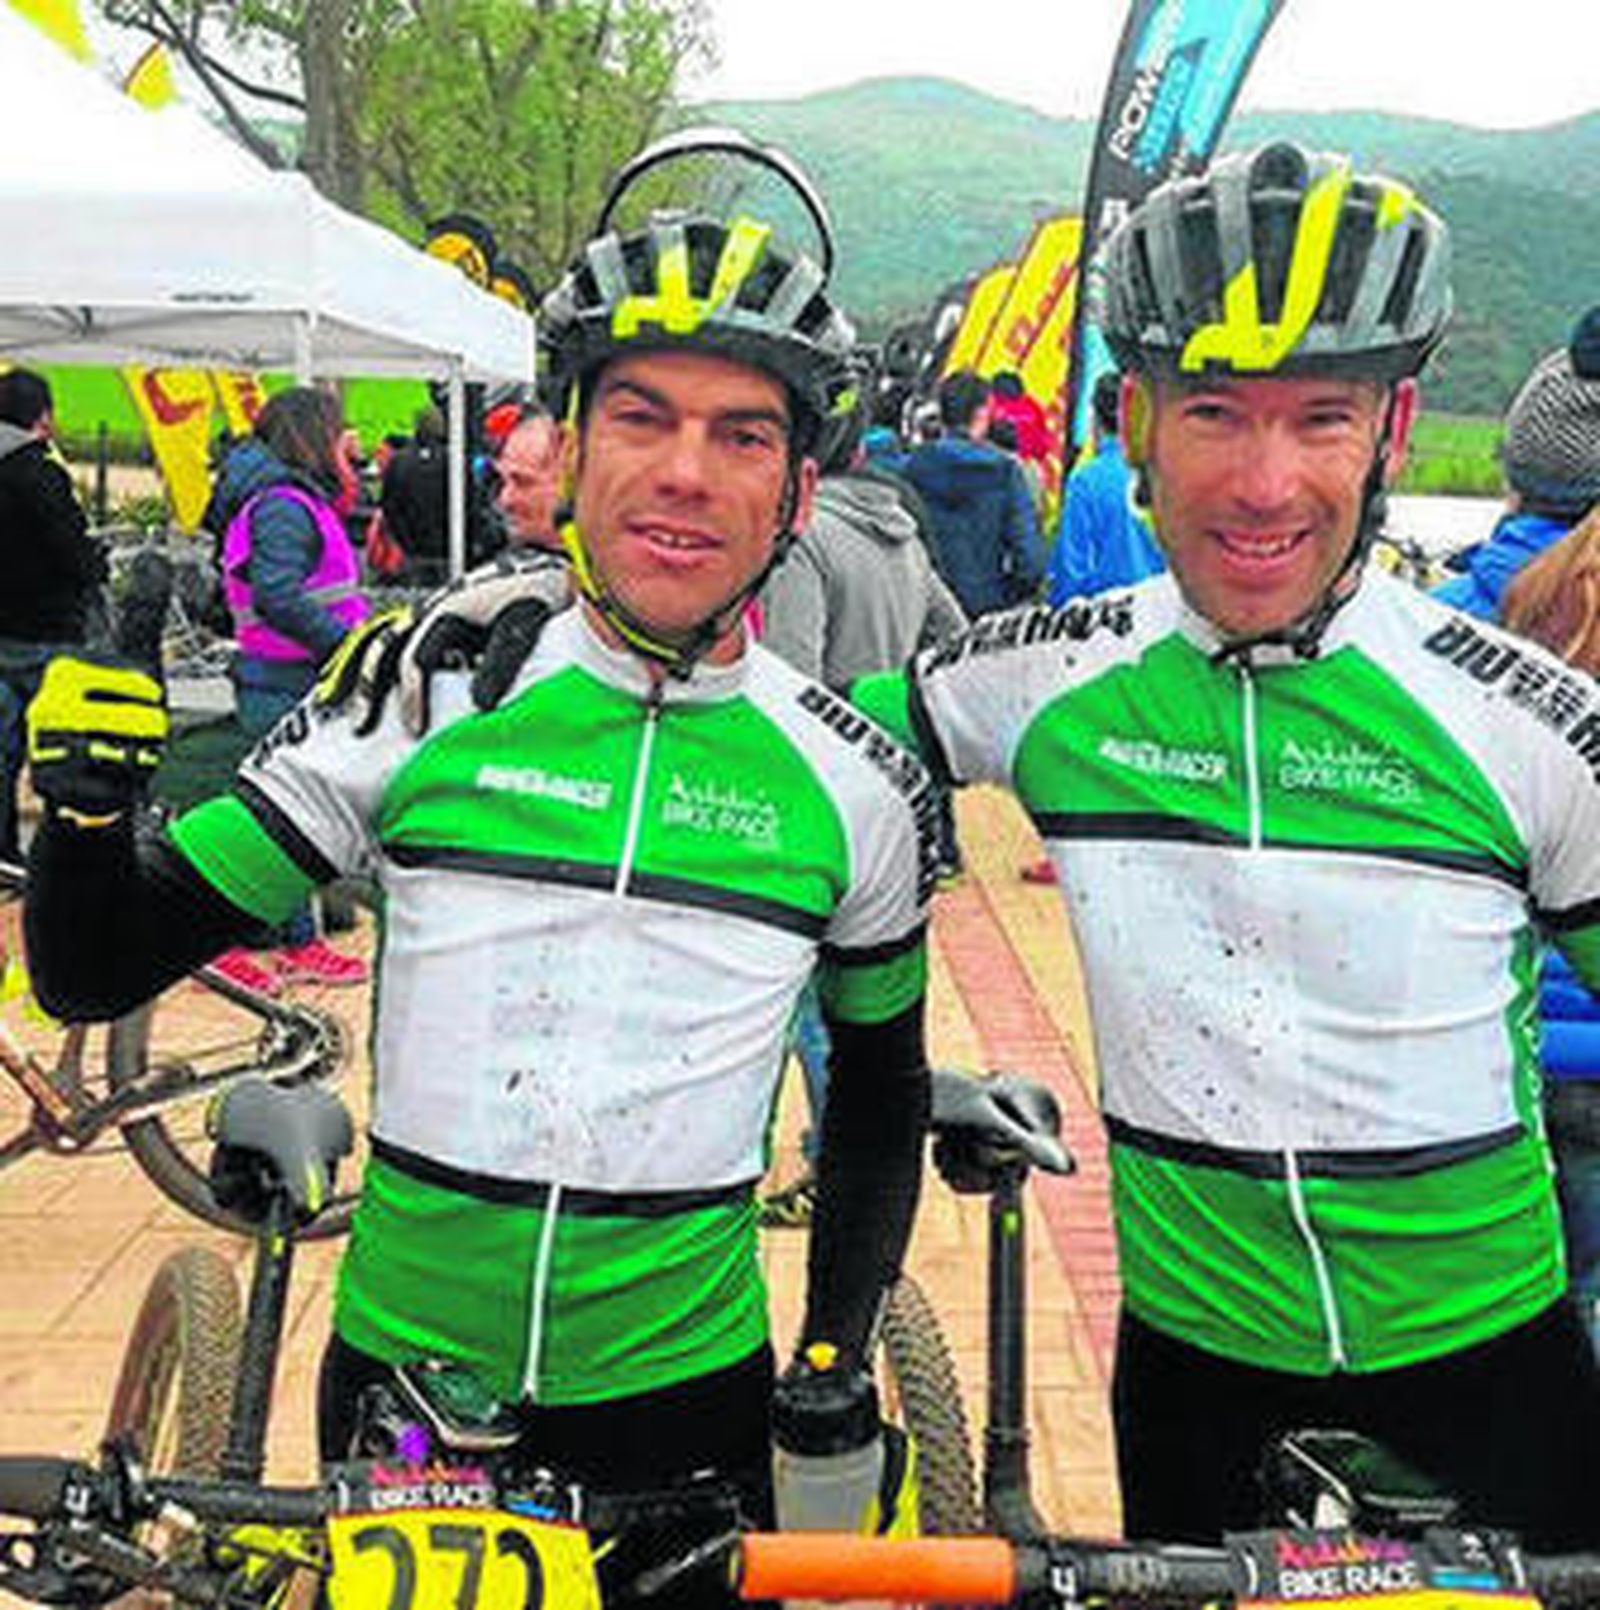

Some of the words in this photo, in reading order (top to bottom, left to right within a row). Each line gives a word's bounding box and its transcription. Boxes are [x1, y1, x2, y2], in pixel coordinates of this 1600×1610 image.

[370, 1485, 429, 1511] BIKE
[431, 1483, 498, 1510] RACE
[1278, 1566, 1342, 1599] BIKE
[1345, 1561, 1421, 1593] RACE
